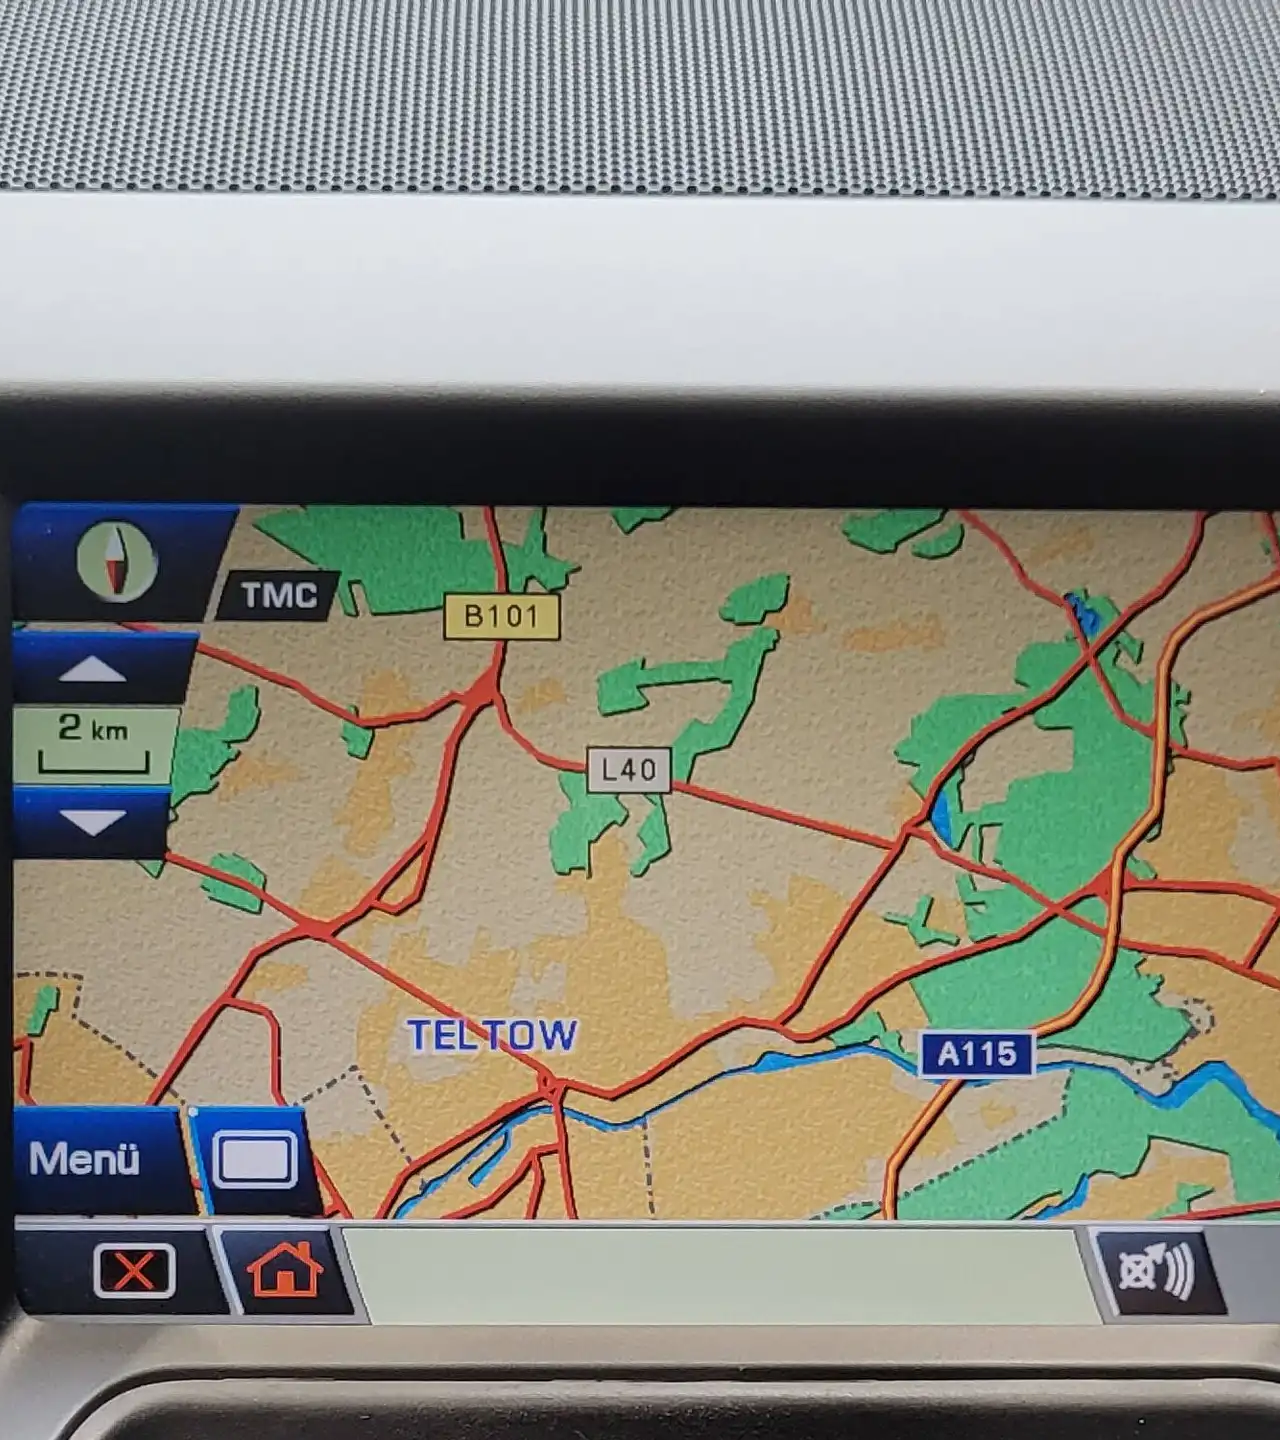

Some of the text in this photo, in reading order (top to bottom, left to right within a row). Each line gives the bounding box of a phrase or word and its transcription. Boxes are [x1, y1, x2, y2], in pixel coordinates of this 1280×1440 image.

[241, 581, 318, 609] TMC
[465, 604, 536, 628] B101
[58, 713, 128, 741] 2 km
[603, 757, 656, 782] L40
[407, 1020, 577, 1050] TELTOW
[937, 1041, 1017, 1067] A115
[28, 1141, 140, 1176] Menü
